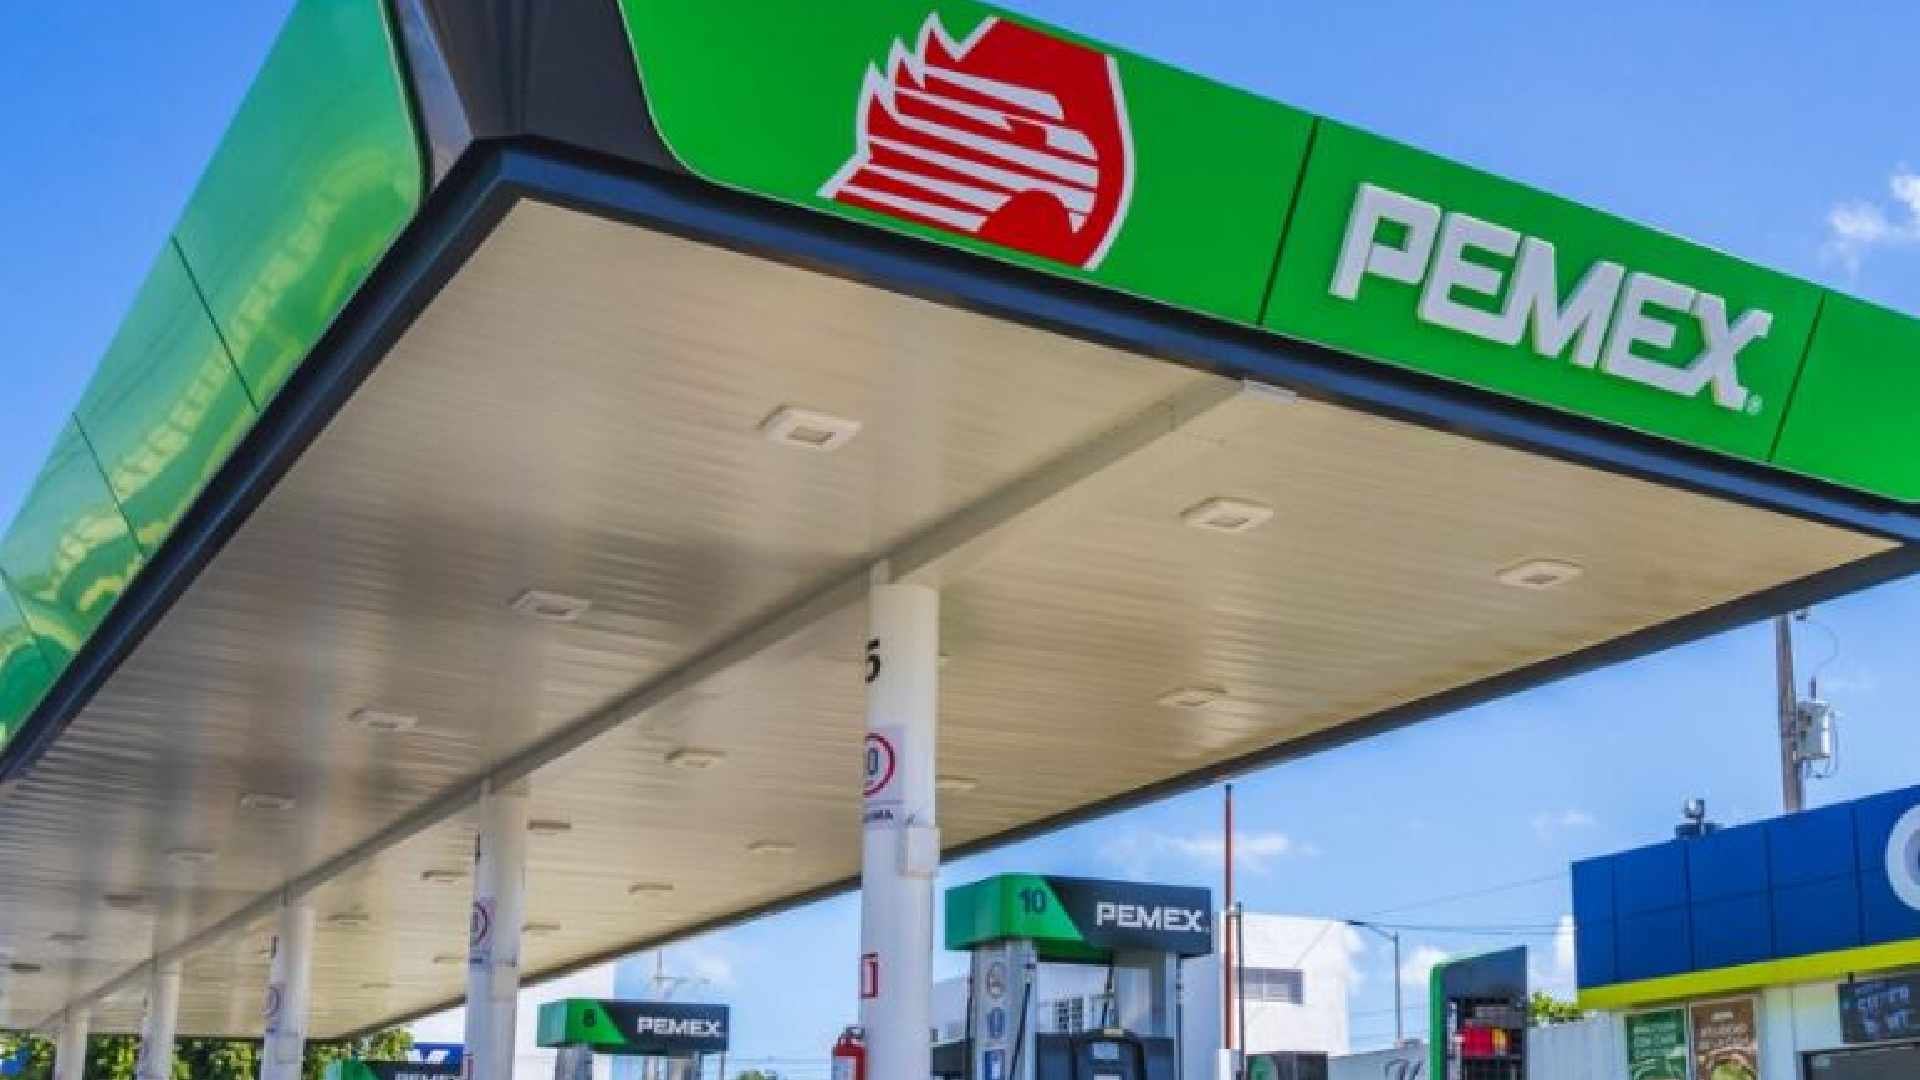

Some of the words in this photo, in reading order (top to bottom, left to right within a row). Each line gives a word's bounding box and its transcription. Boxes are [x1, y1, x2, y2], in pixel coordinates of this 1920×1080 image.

[1329, 183, 1773, 411] PEMEX
[1019, 887, 1046, 914] 10
[1095, 901, 1202, 932] PEMEX
[636, 1015, 720, 1038] PEMEX
